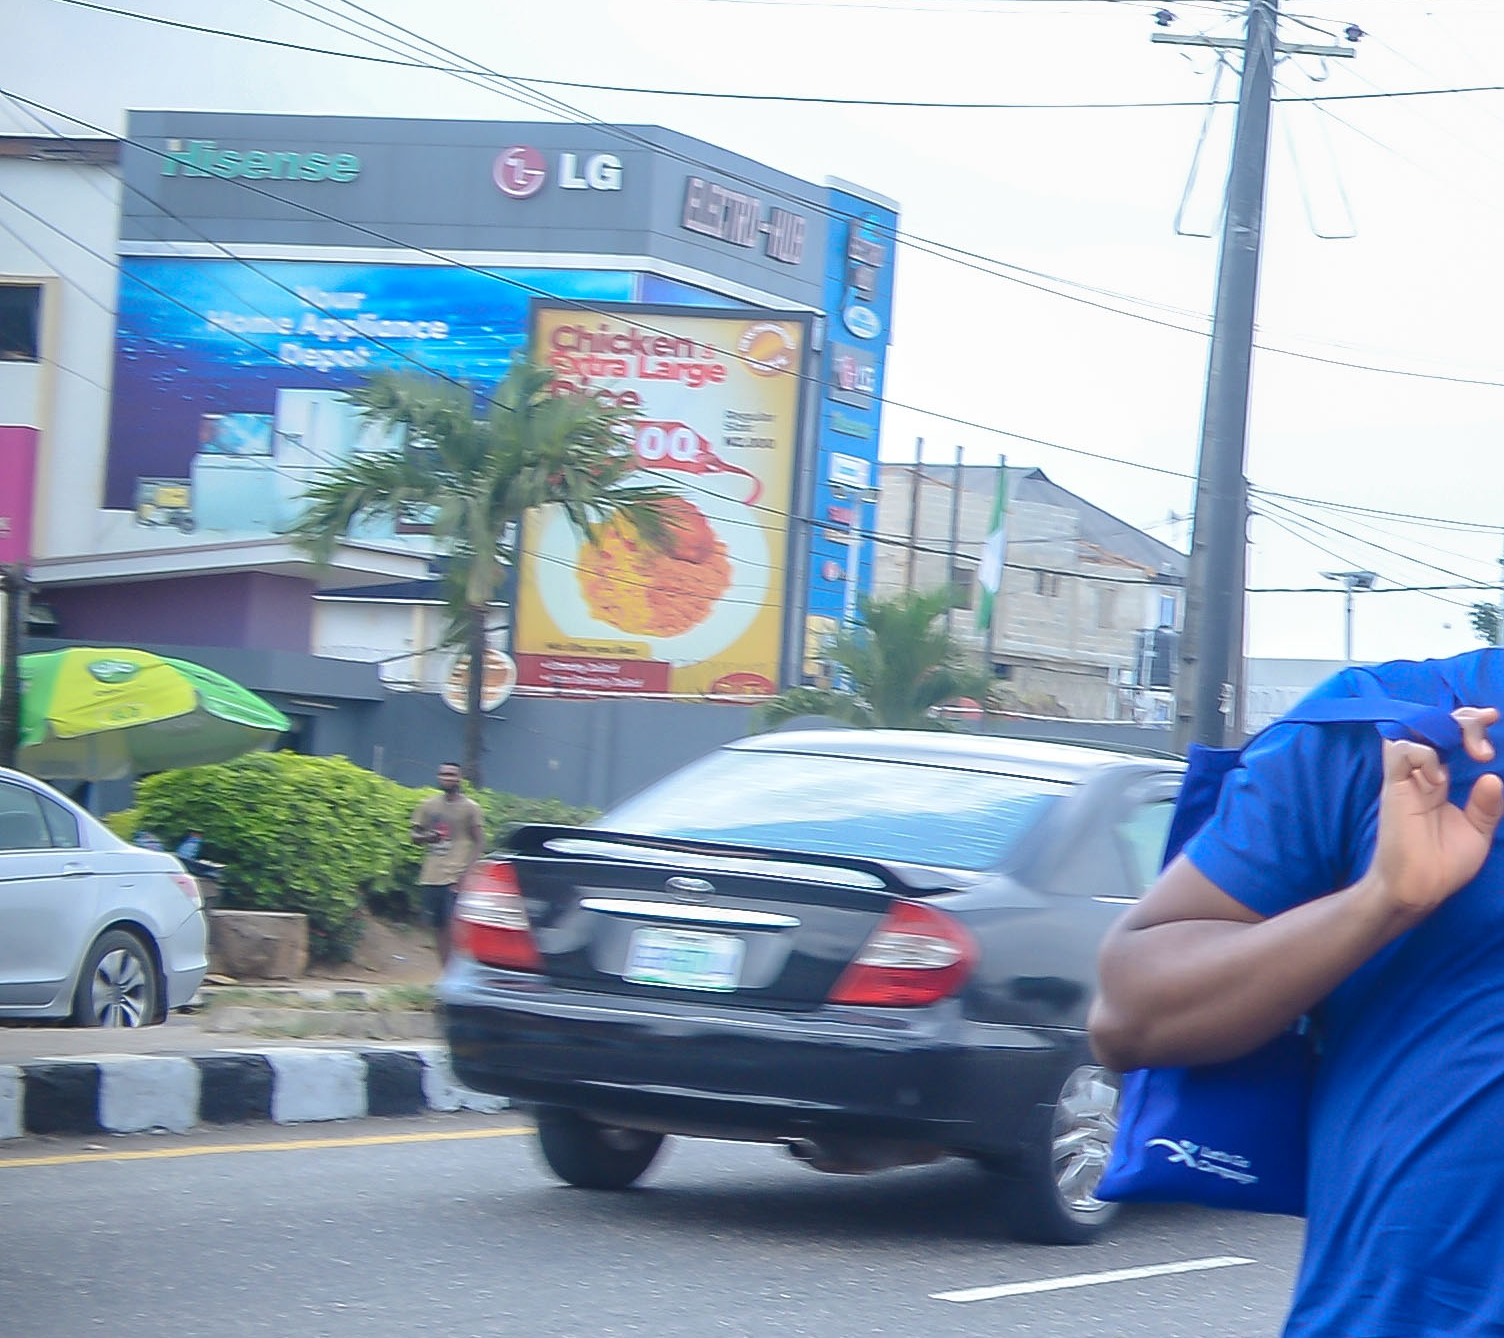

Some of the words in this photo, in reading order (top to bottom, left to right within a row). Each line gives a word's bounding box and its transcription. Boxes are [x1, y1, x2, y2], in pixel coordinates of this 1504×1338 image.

[160, 140, 360, 182] Hisense
[558, 153, 623, 190] LG
[207, 309, 295, 335] Home
[301, 312, 448, 341] Appliance
[550, 323, 696, 359] Chicken
[279, 342, 368, 372] Depot
[548, 349, 627, 378] Extra
[637, 356, 727, 388] Large
